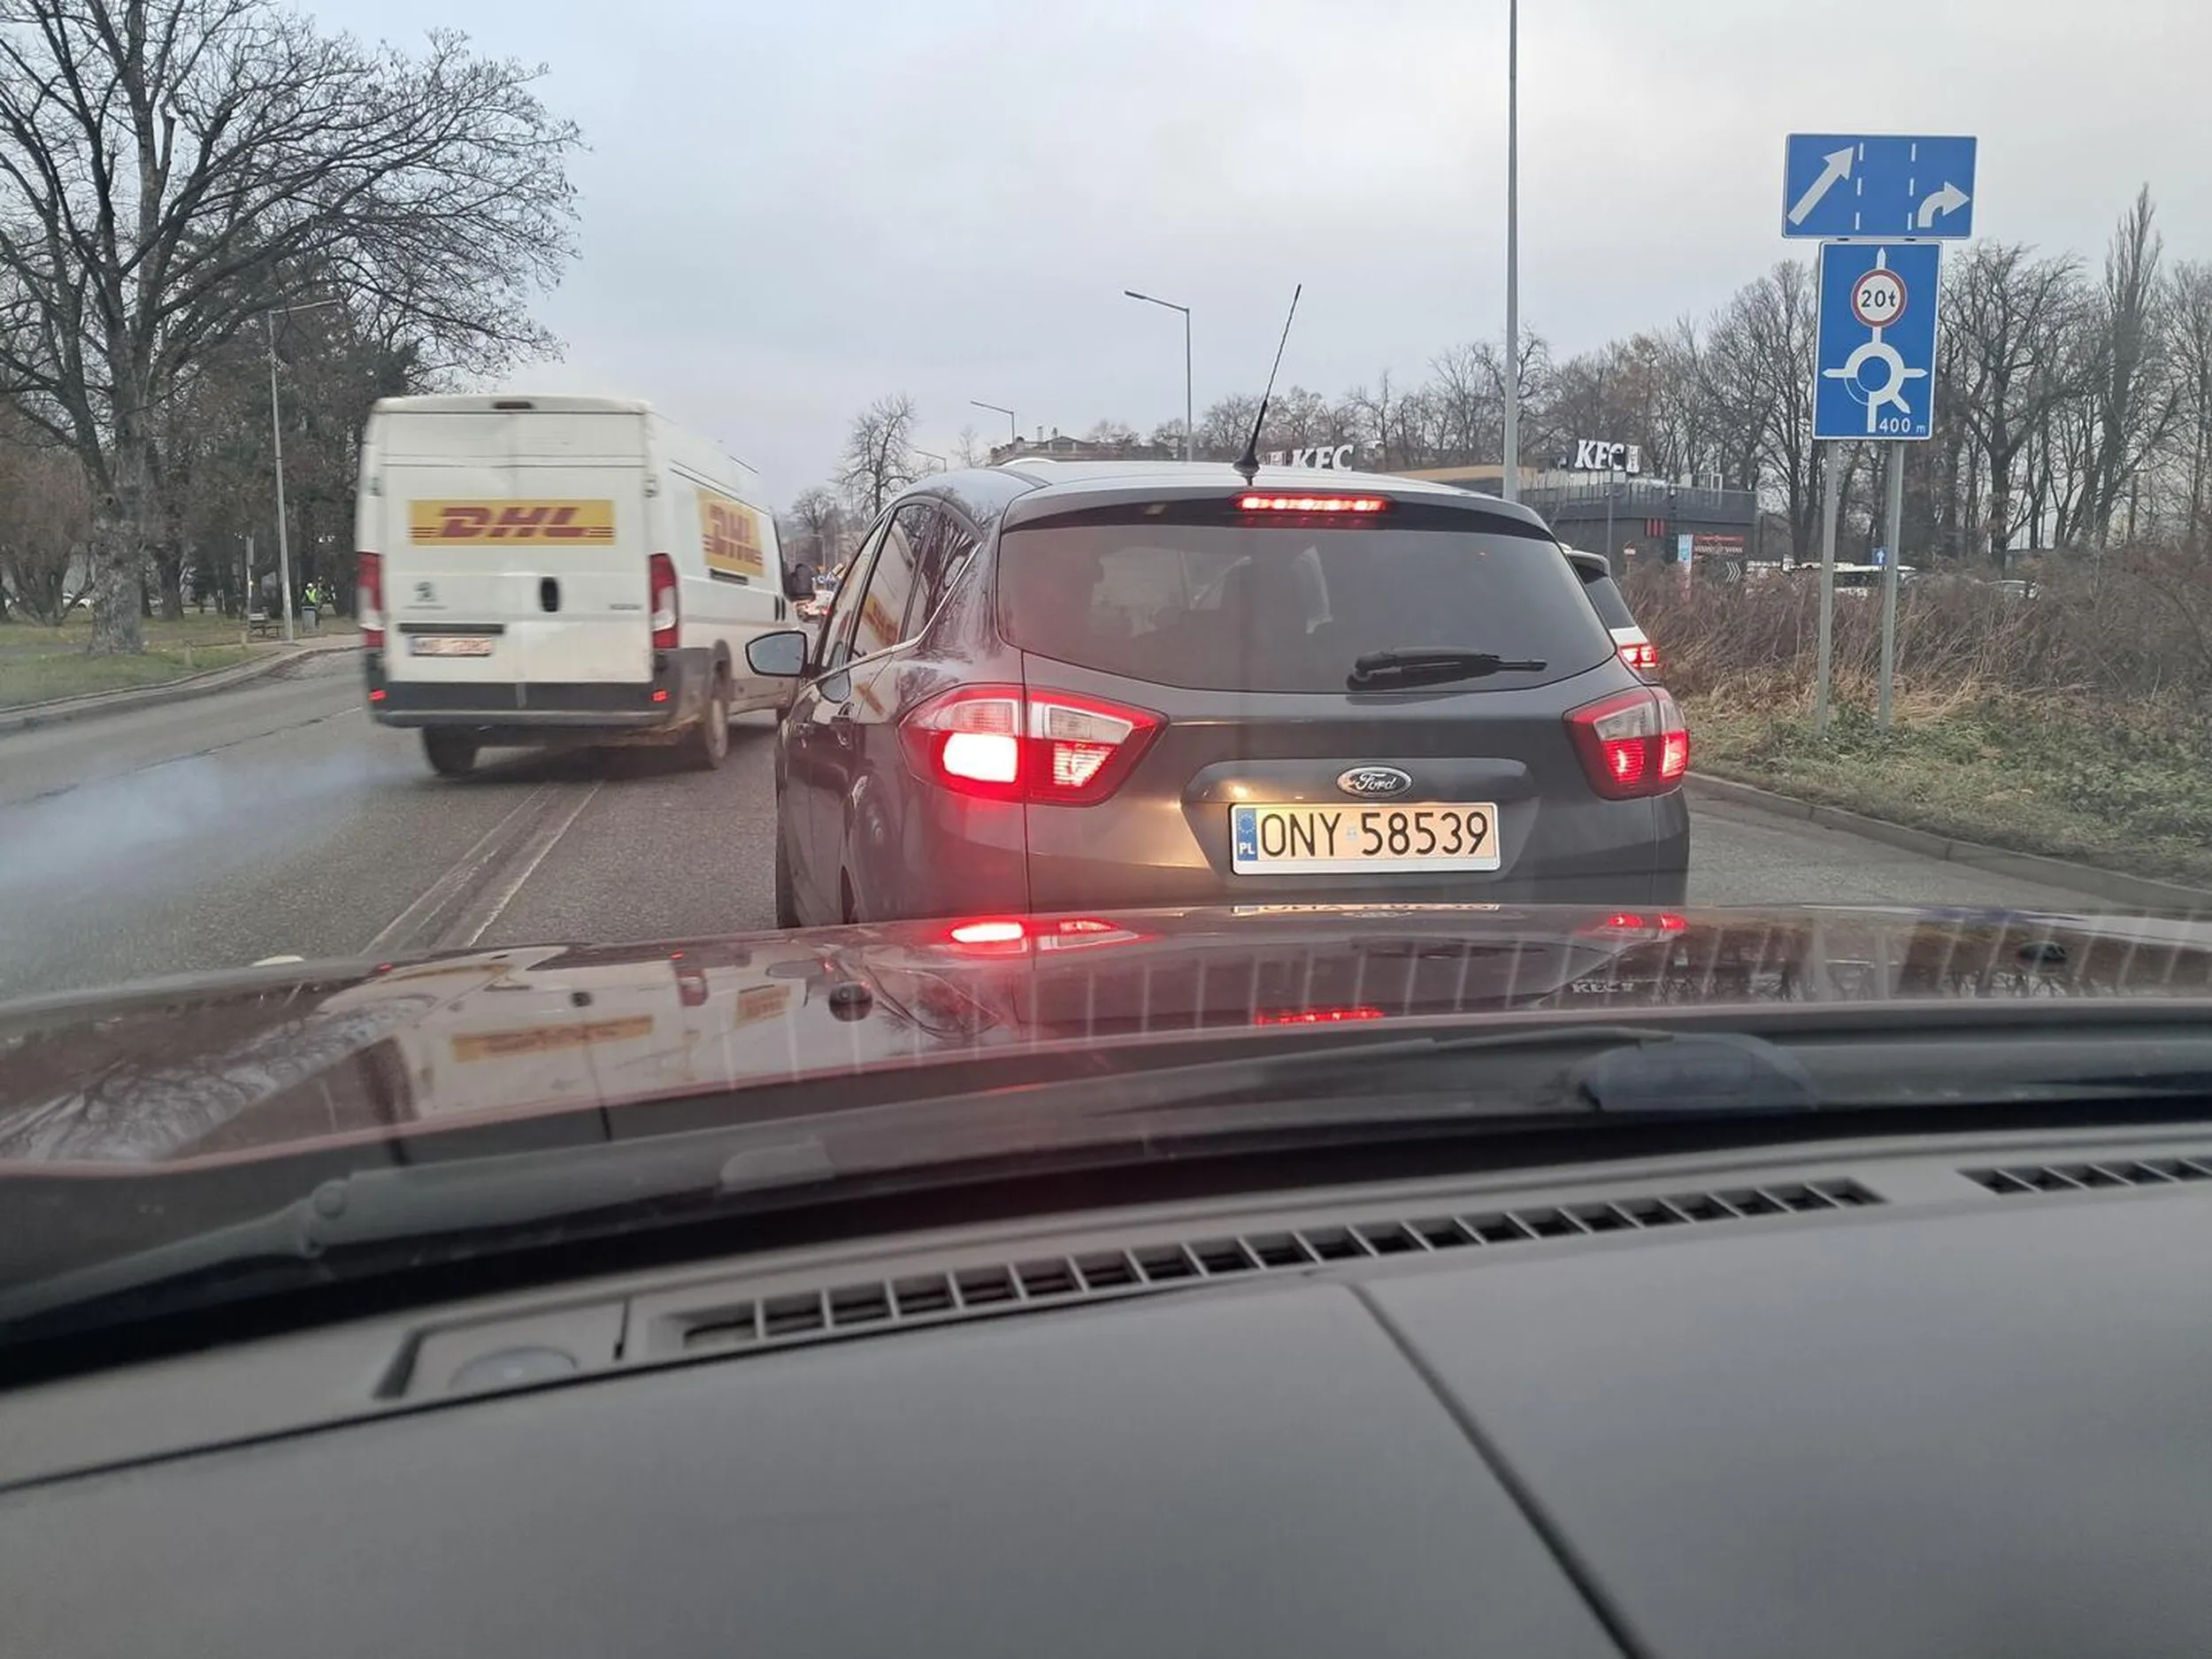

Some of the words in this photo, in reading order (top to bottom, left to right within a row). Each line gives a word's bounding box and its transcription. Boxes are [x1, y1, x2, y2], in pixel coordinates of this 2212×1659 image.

[1879, 418, 1911, 433] 400
[1916, 425, 1926, 434] m
[1293, 444, 1354, 472] KFC
[1574, 440, 1624, 471] KFC
[438, 506, 587, 538] DHL
[709, 503, 757, 564] DHL
[1355, 772, 1399, 790] Ford
[1261, 812, 1341, 856] ONY
[1361, 811, 1488, 856] 58539
[1240, 842, 1255, 855] PL
